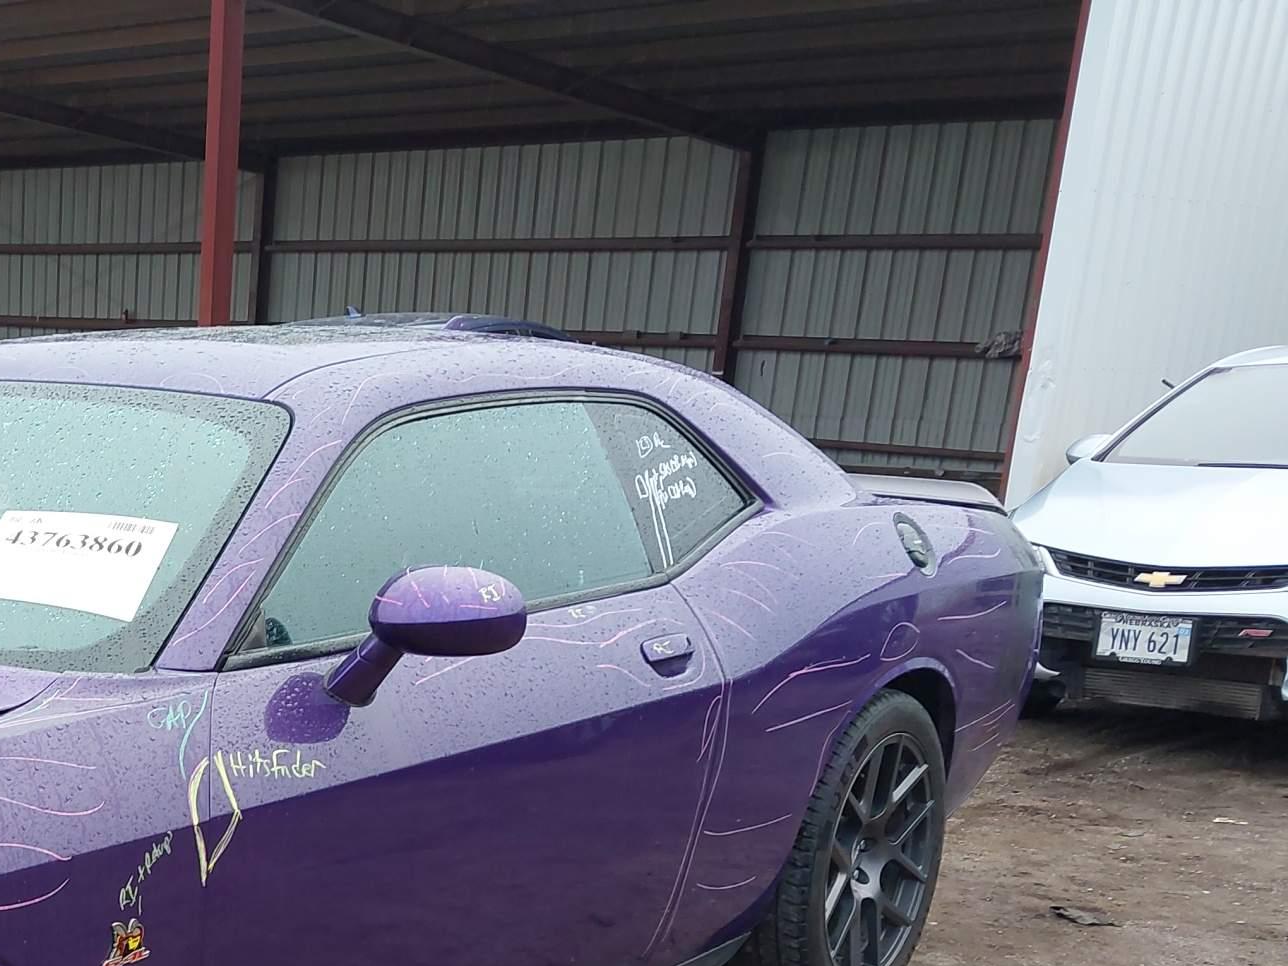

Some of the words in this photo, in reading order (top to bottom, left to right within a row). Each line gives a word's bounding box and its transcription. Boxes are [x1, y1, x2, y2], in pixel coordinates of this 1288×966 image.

[5, 529, 143, 557] 43763860
[1111, 627, 1142, 651] YNY
[1147, 631, 1180, 656] 621
